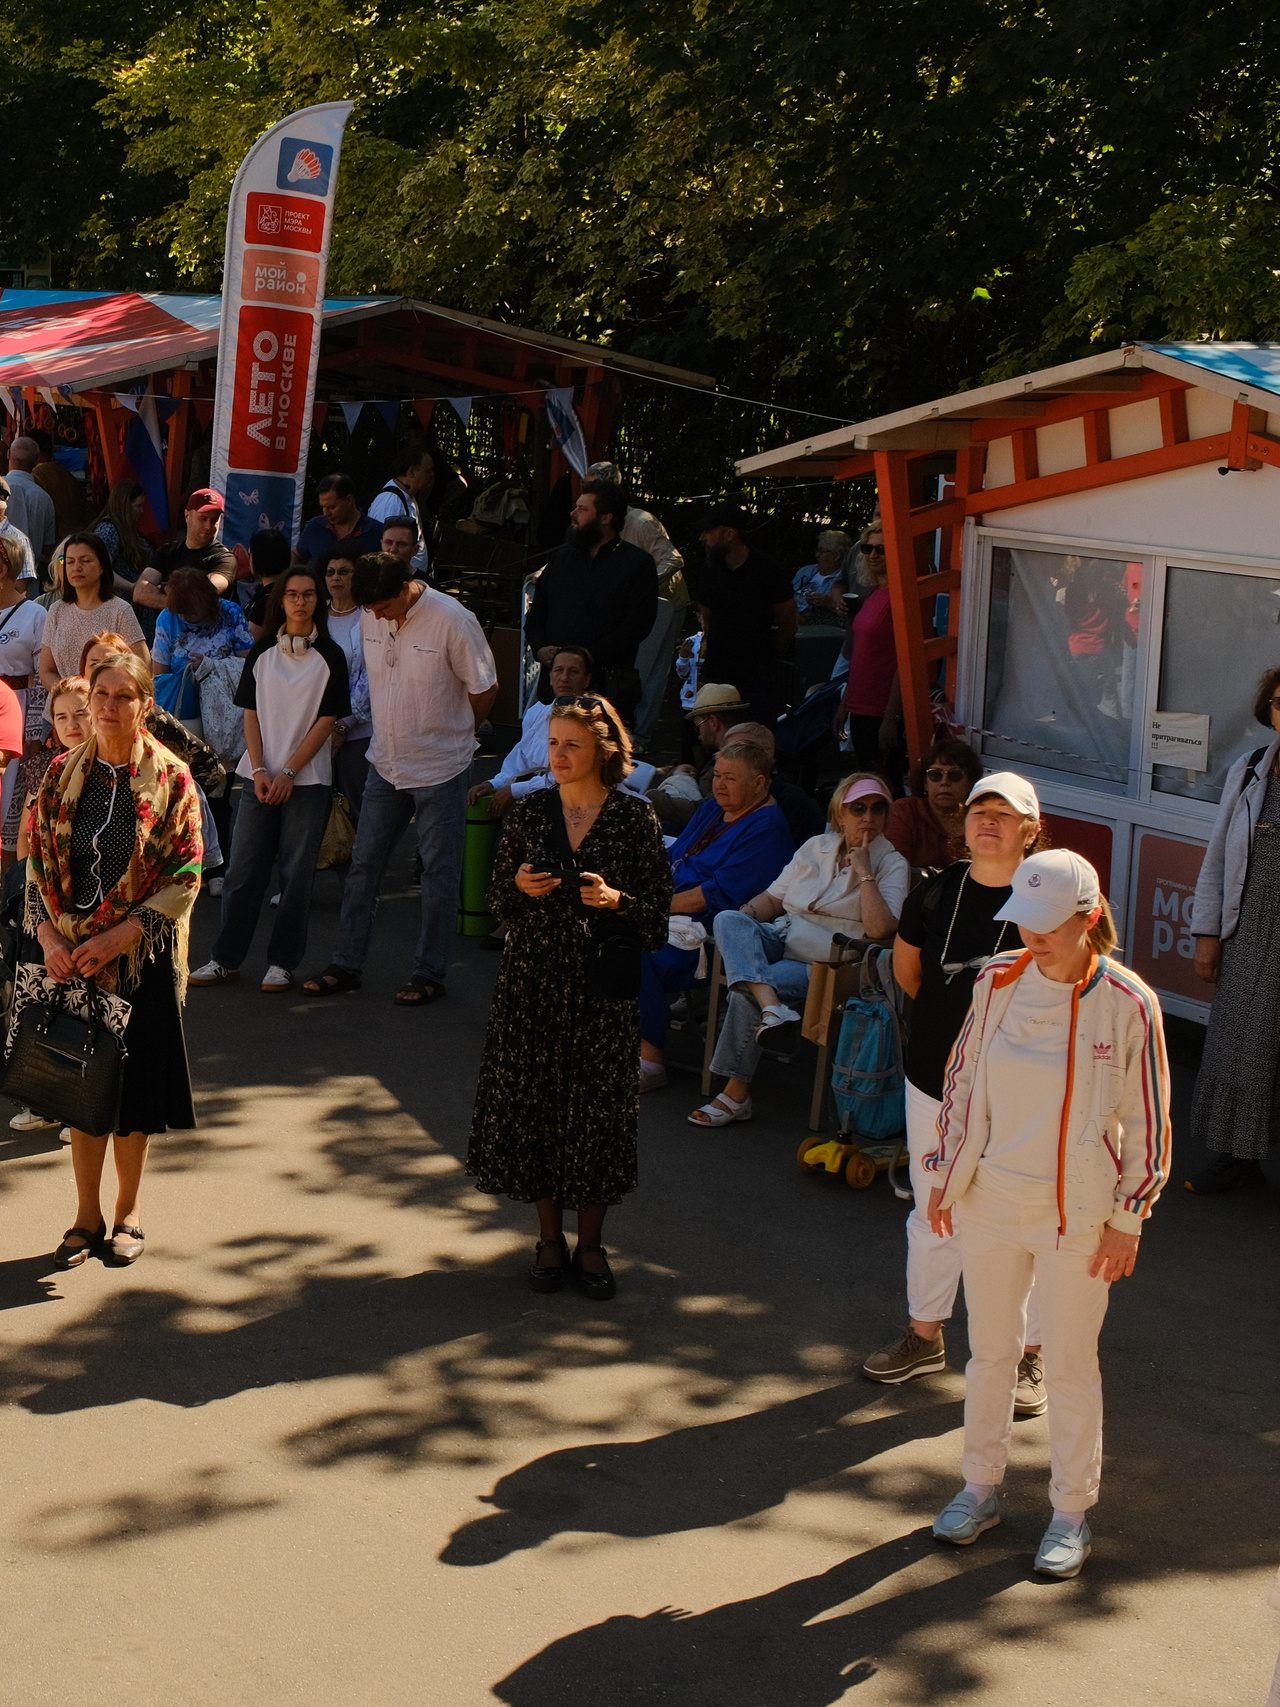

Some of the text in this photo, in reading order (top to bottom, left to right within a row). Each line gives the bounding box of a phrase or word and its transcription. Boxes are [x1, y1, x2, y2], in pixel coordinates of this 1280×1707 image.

[284, 211, 310, 220] ПРОЕКТ
[284, 218, 302, 226] МЭРА
[283, 225, 313, 235] МОСКВЫ
[246, 330, 279, 448] ЛЕТО
[275, 333, 297, 450] В МОСКВЕ
[1152, 721, 1161, 729] Не
[1151, 733, 1202, 746] притрагиваться
